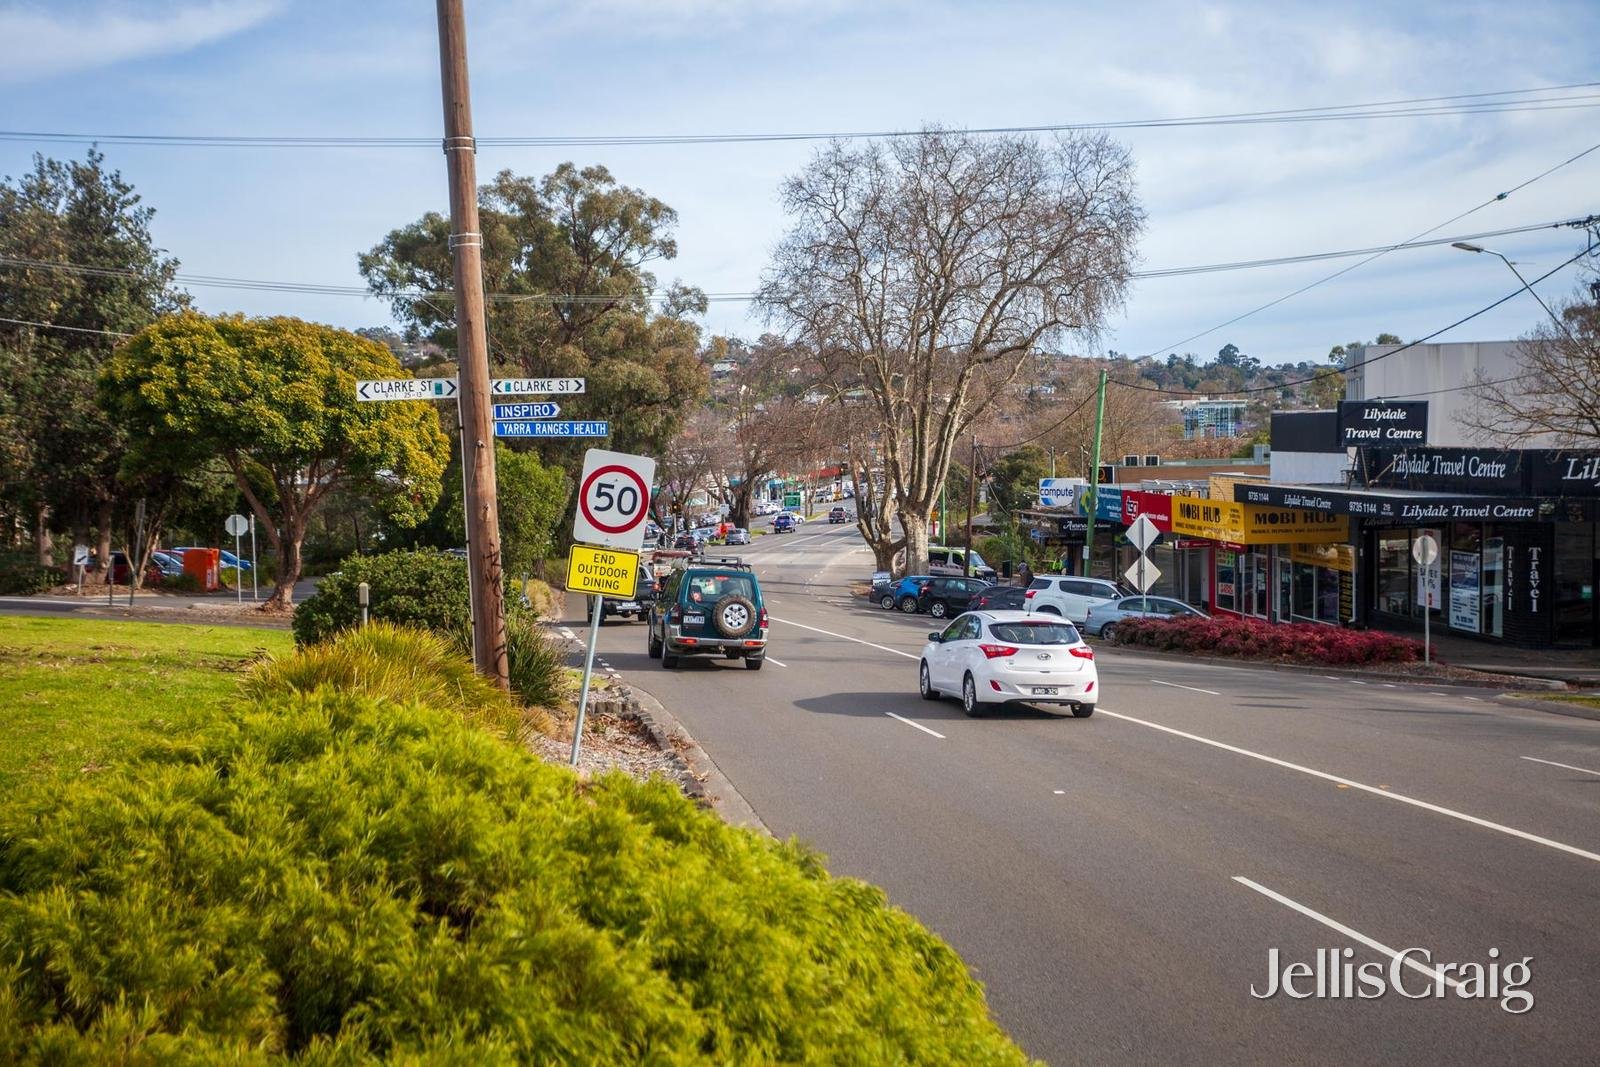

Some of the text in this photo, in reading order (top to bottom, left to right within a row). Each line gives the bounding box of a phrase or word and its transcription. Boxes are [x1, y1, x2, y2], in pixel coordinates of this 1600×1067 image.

[373, 380, 433, 394] CLARKE ST
[513, 380, 571, 392] CLARKE ST
[500, 404, 550, 417] INSPIRO
[1363, 408, 1407, 421] Lilydale
[503, 423, 606, 435] YARRA RANGES HEALTH
[1345, 427, 1423, 440] Travel Centre
[1391, 454, 1506, 479] Lilydale Travel Centre
[1561, 457, 1600, 487] Lil
[593, 482, 638, 516] 50
[1040, 487, 1073, 499] compute
[1179, 502, 1200, 520] MOBI
[1203, 505, 1221, 523] HUB
[1255, 511, 1296, 525] MOBI
[1401, 505, 1448, 521] Lilydale
[1452, 506, 1490, 517] Travel
[1493, 506, 1535, 518] Centre
[593, 553, 616, 565] END
[577, 563, 629, 579] OUTDOOR
[583, 576, 620, 590] DINING
[1528, 546, 1543, 613] Travel
